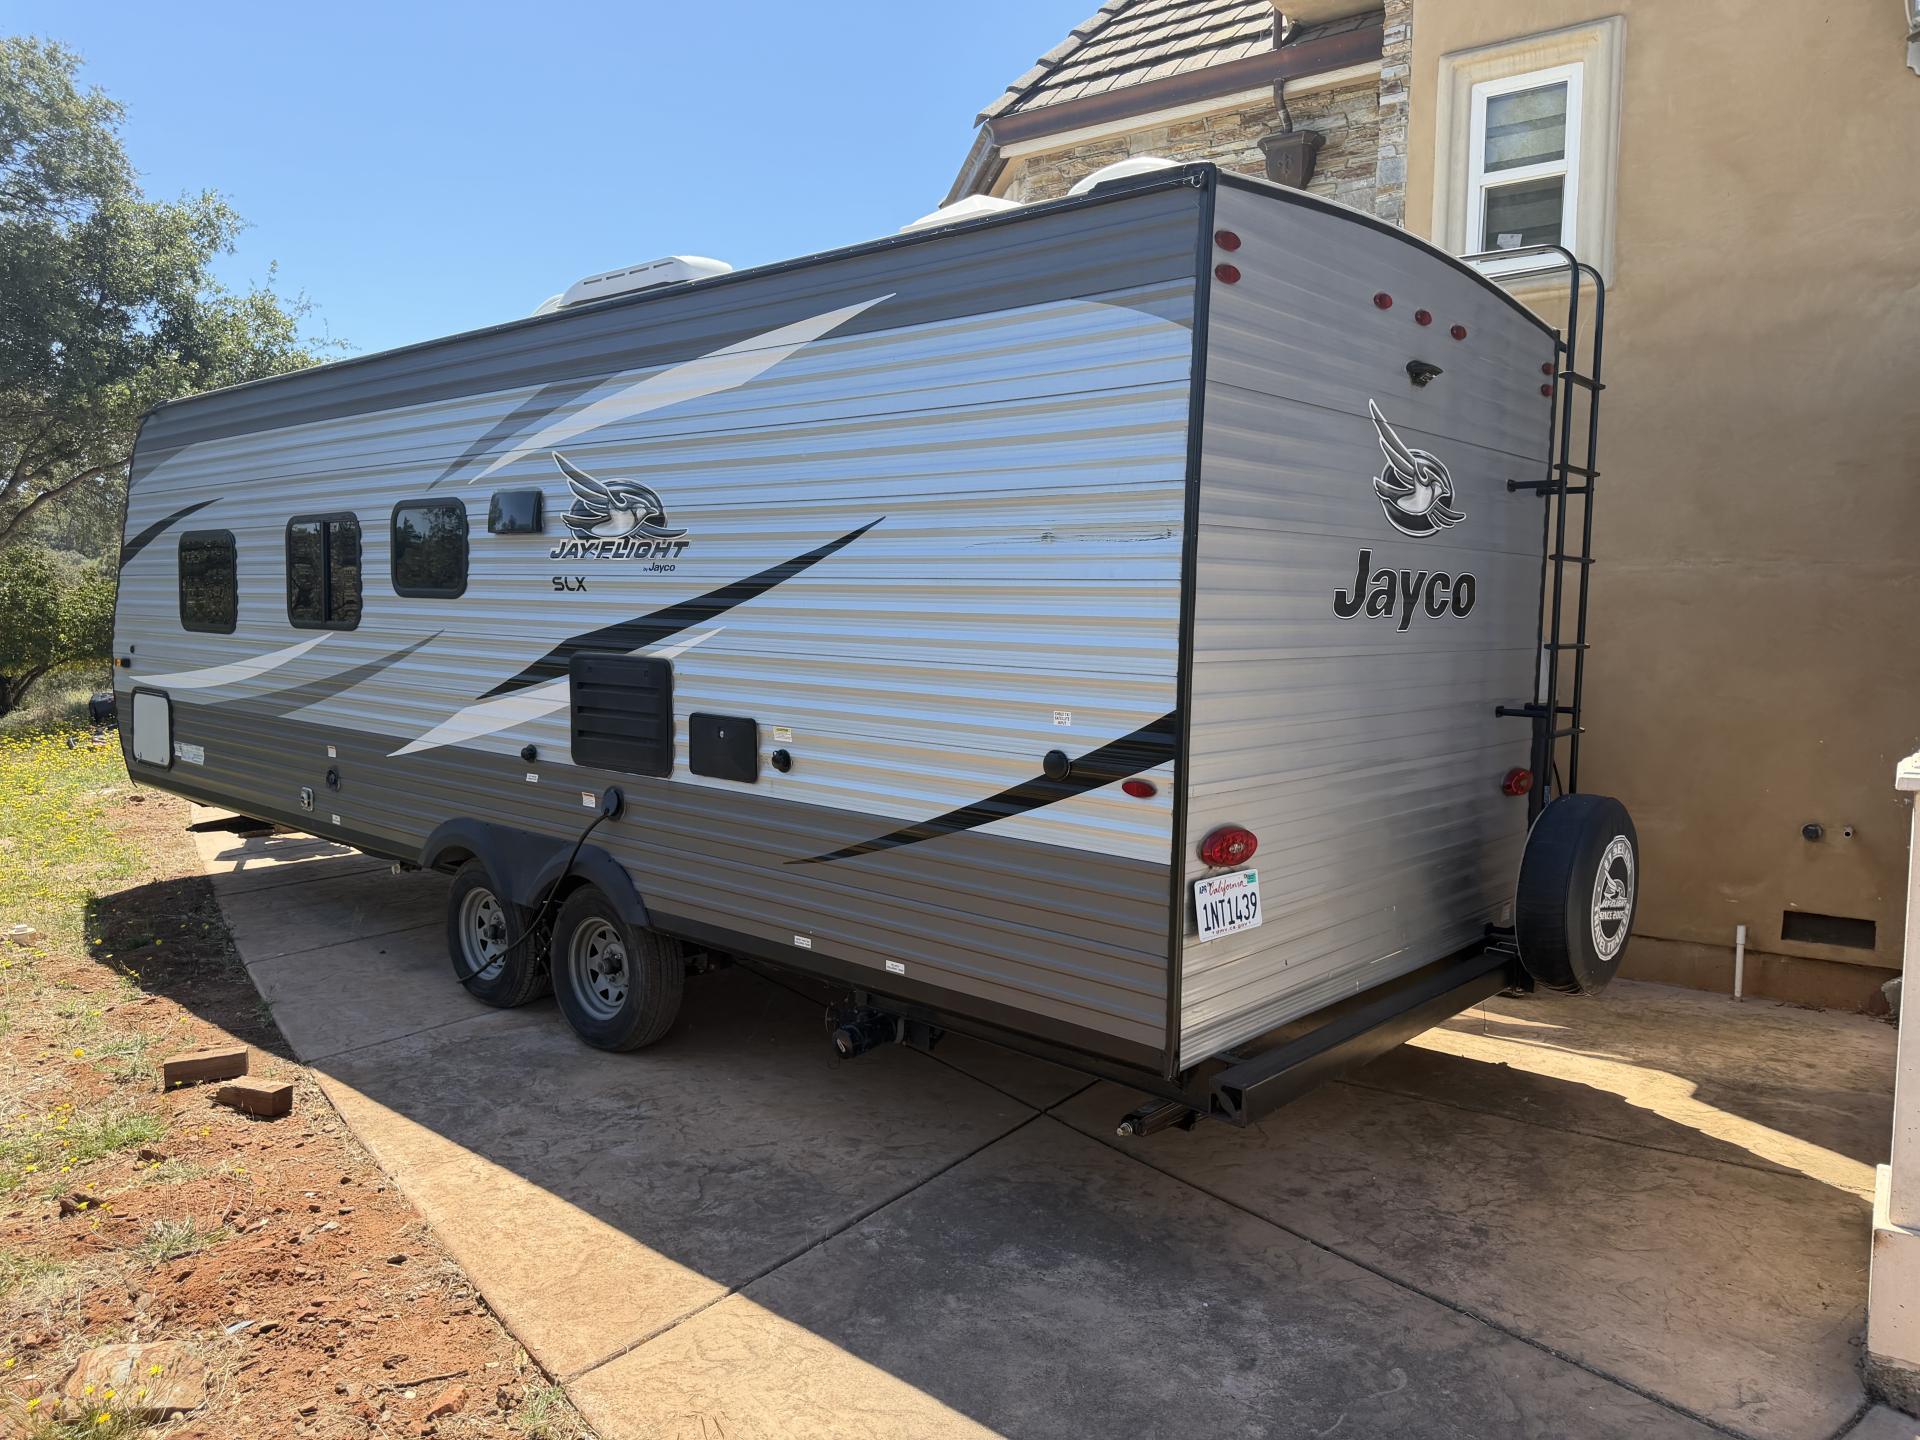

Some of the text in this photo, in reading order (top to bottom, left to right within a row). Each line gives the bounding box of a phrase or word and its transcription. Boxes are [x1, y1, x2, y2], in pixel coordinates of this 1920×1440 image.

[648, 562, 675, 573] Jayco
[552, 577, 587, 591] SLX
[1333, 548, 1476, 632] Jayco
[1207, 880, 1248, 896] California
[1203, 892, 1257, 932] 1NT1439
